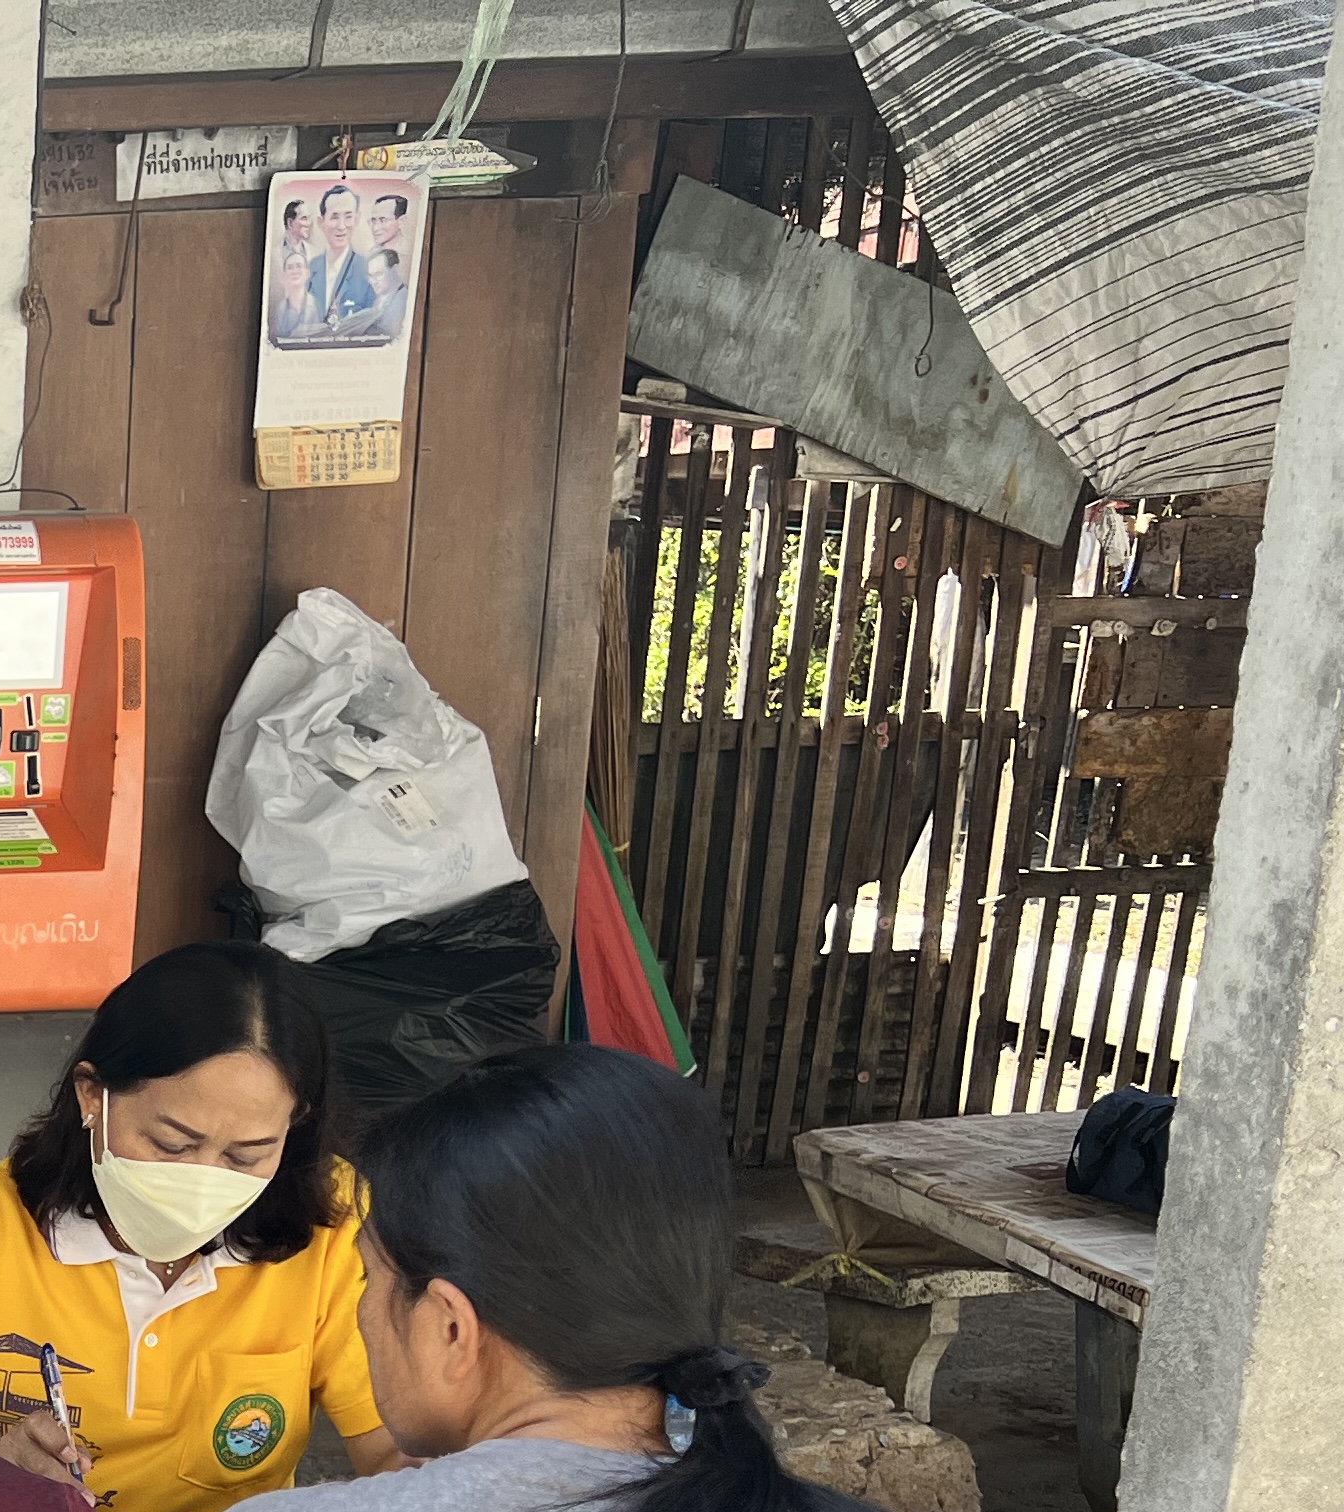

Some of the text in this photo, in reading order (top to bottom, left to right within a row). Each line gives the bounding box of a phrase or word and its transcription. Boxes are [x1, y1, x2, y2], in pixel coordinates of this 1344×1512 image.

[144, 136, 268, 175] ที่นี่จำหน่ายบุหรี่
[0, 913, 99, 950] บุญเติม
